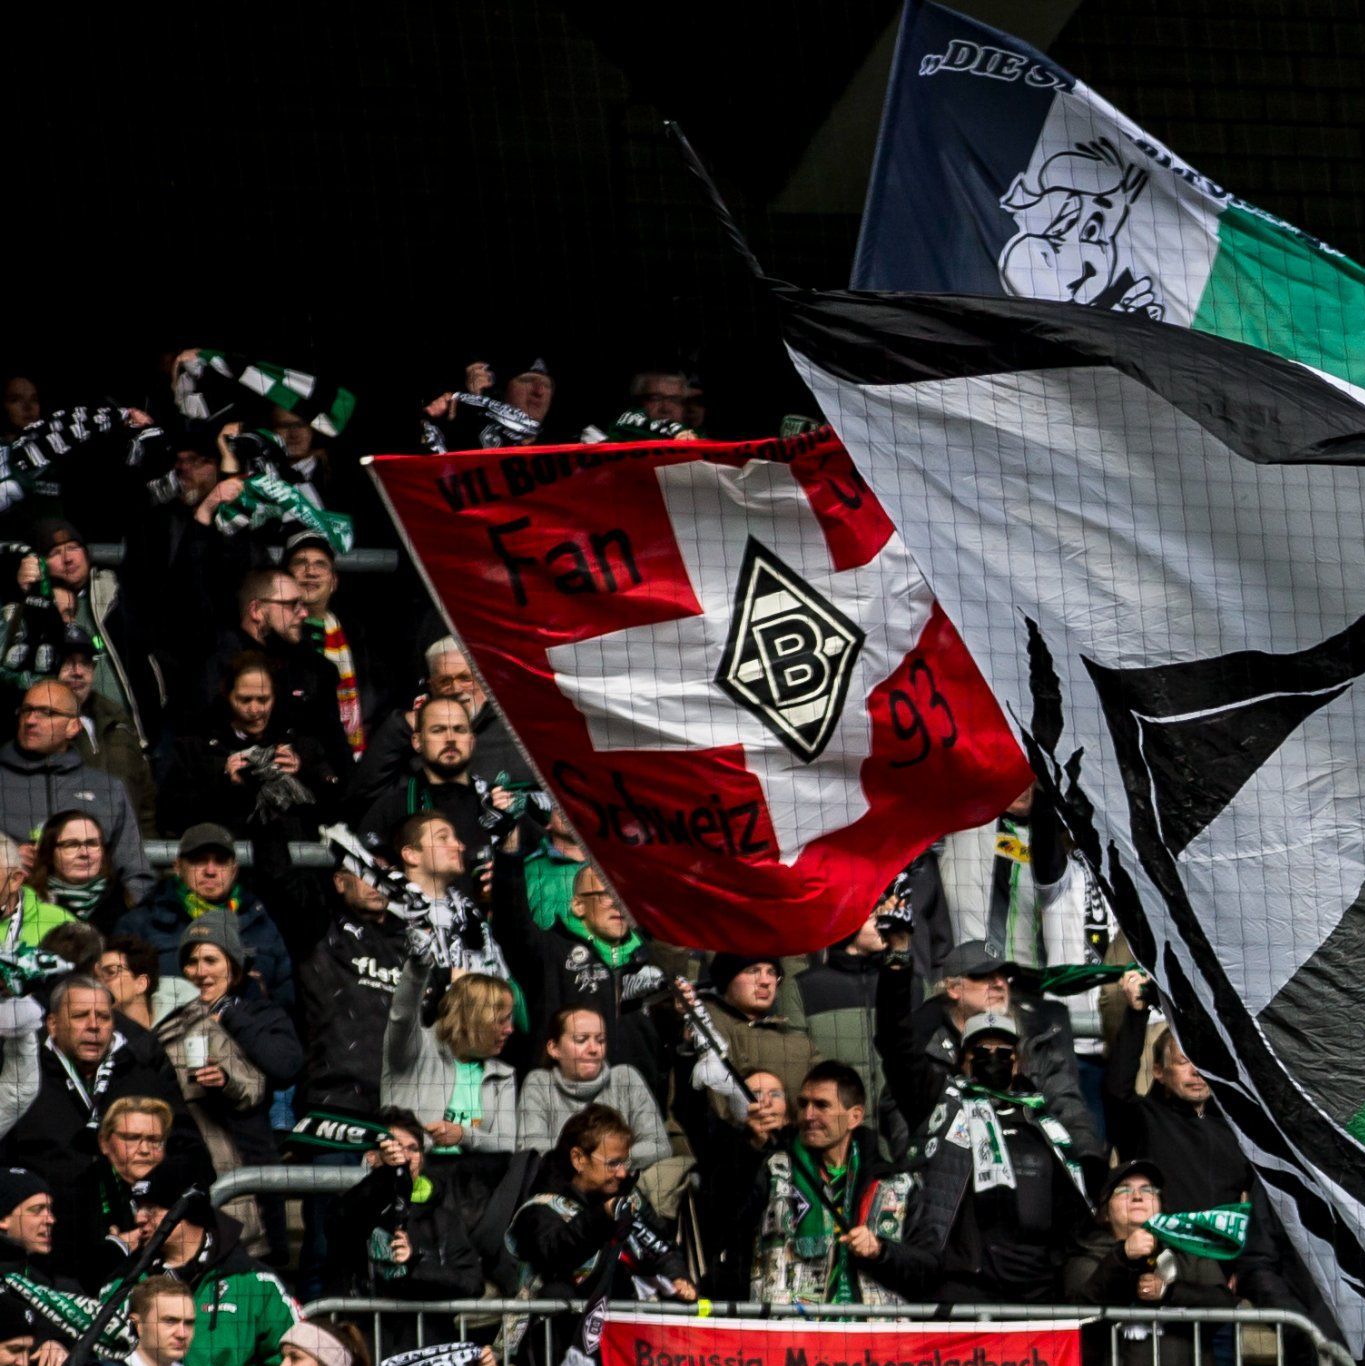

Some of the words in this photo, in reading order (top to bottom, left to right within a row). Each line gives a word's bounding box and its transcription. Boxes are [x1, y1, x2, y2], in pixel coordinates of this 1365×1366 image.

[486, 516, 643, 609] Fan
[888, 656, 960, 769] 93
[551, 759, 772, 858] Schweiz
